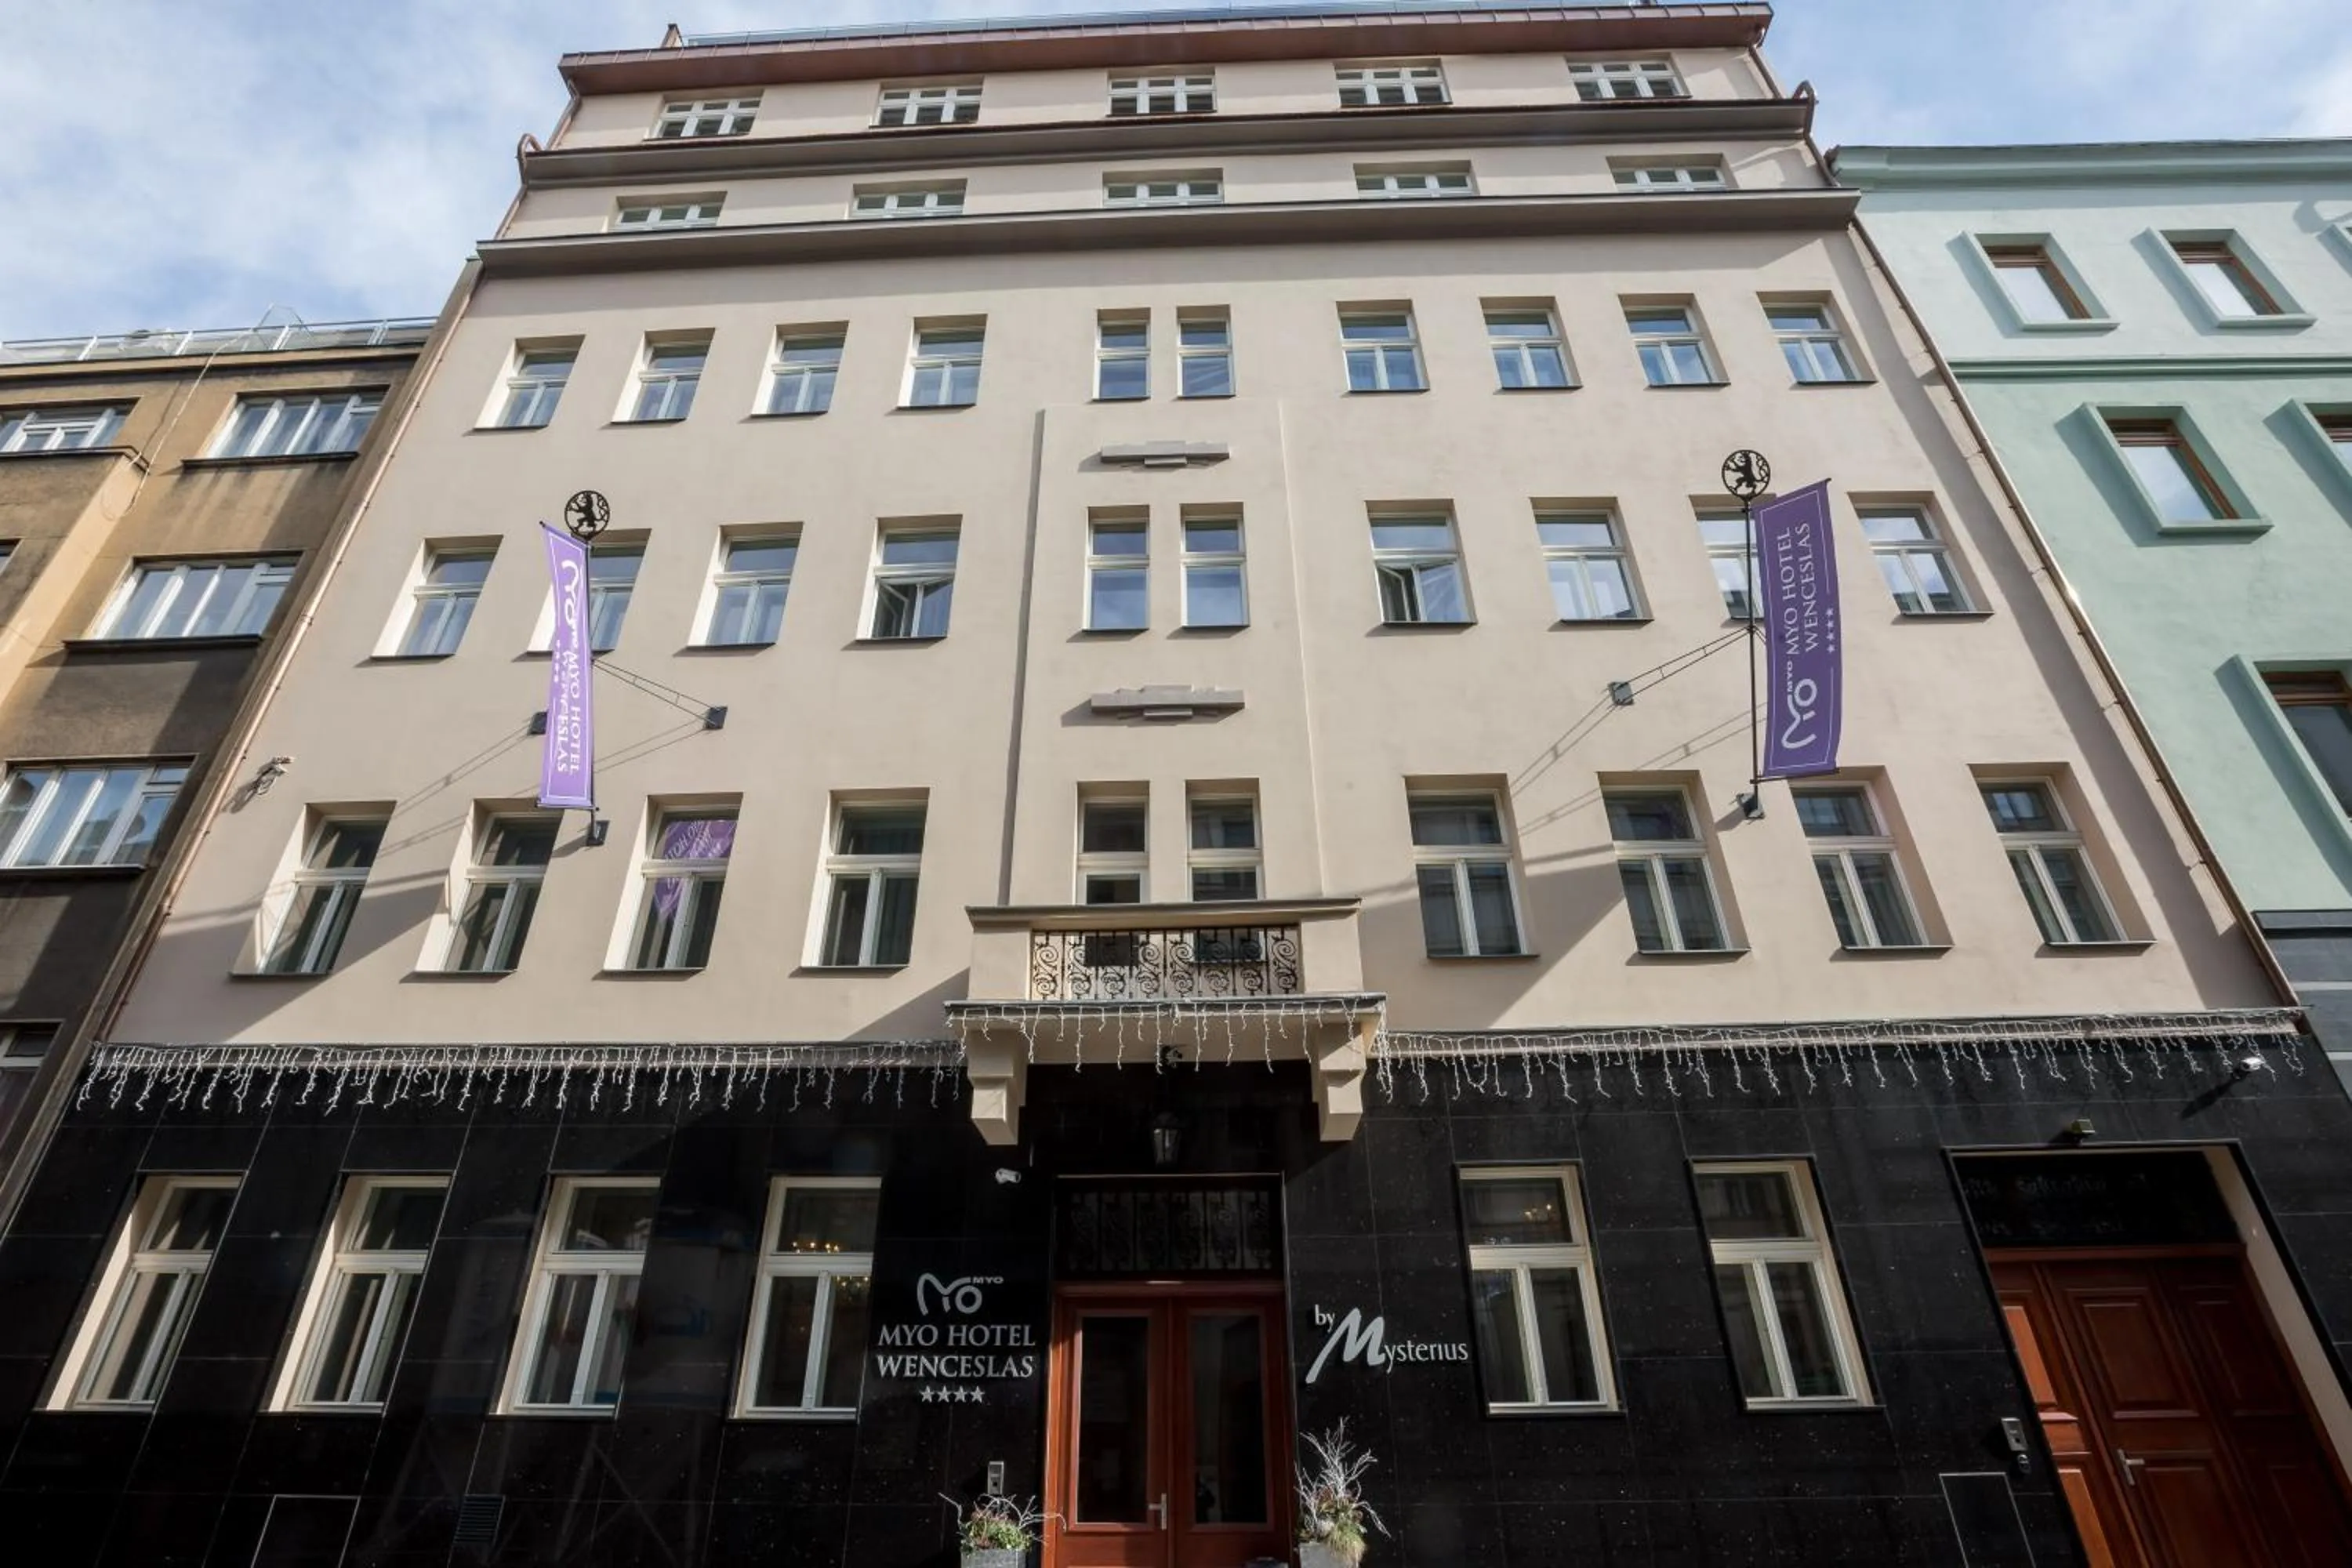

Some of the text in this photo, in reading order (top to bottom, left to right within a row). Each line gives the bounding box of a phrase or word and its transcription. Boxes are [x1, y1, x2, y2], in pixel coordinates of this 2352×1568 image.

[1777, 526, 1800, 655] MYO HOTEL
[1795, 522, 1820, 652] WENCESLAS
[568, 652, 581, 775] MYO HOTEL
[877, 1324, 1036, 1347] MYO HOTEL
[1305, 1307, 1468, 1384] Mysterius
[1314, 1304, 1335, 1333] by
[876, 1354, 1034, 1378] WENCESLAS
